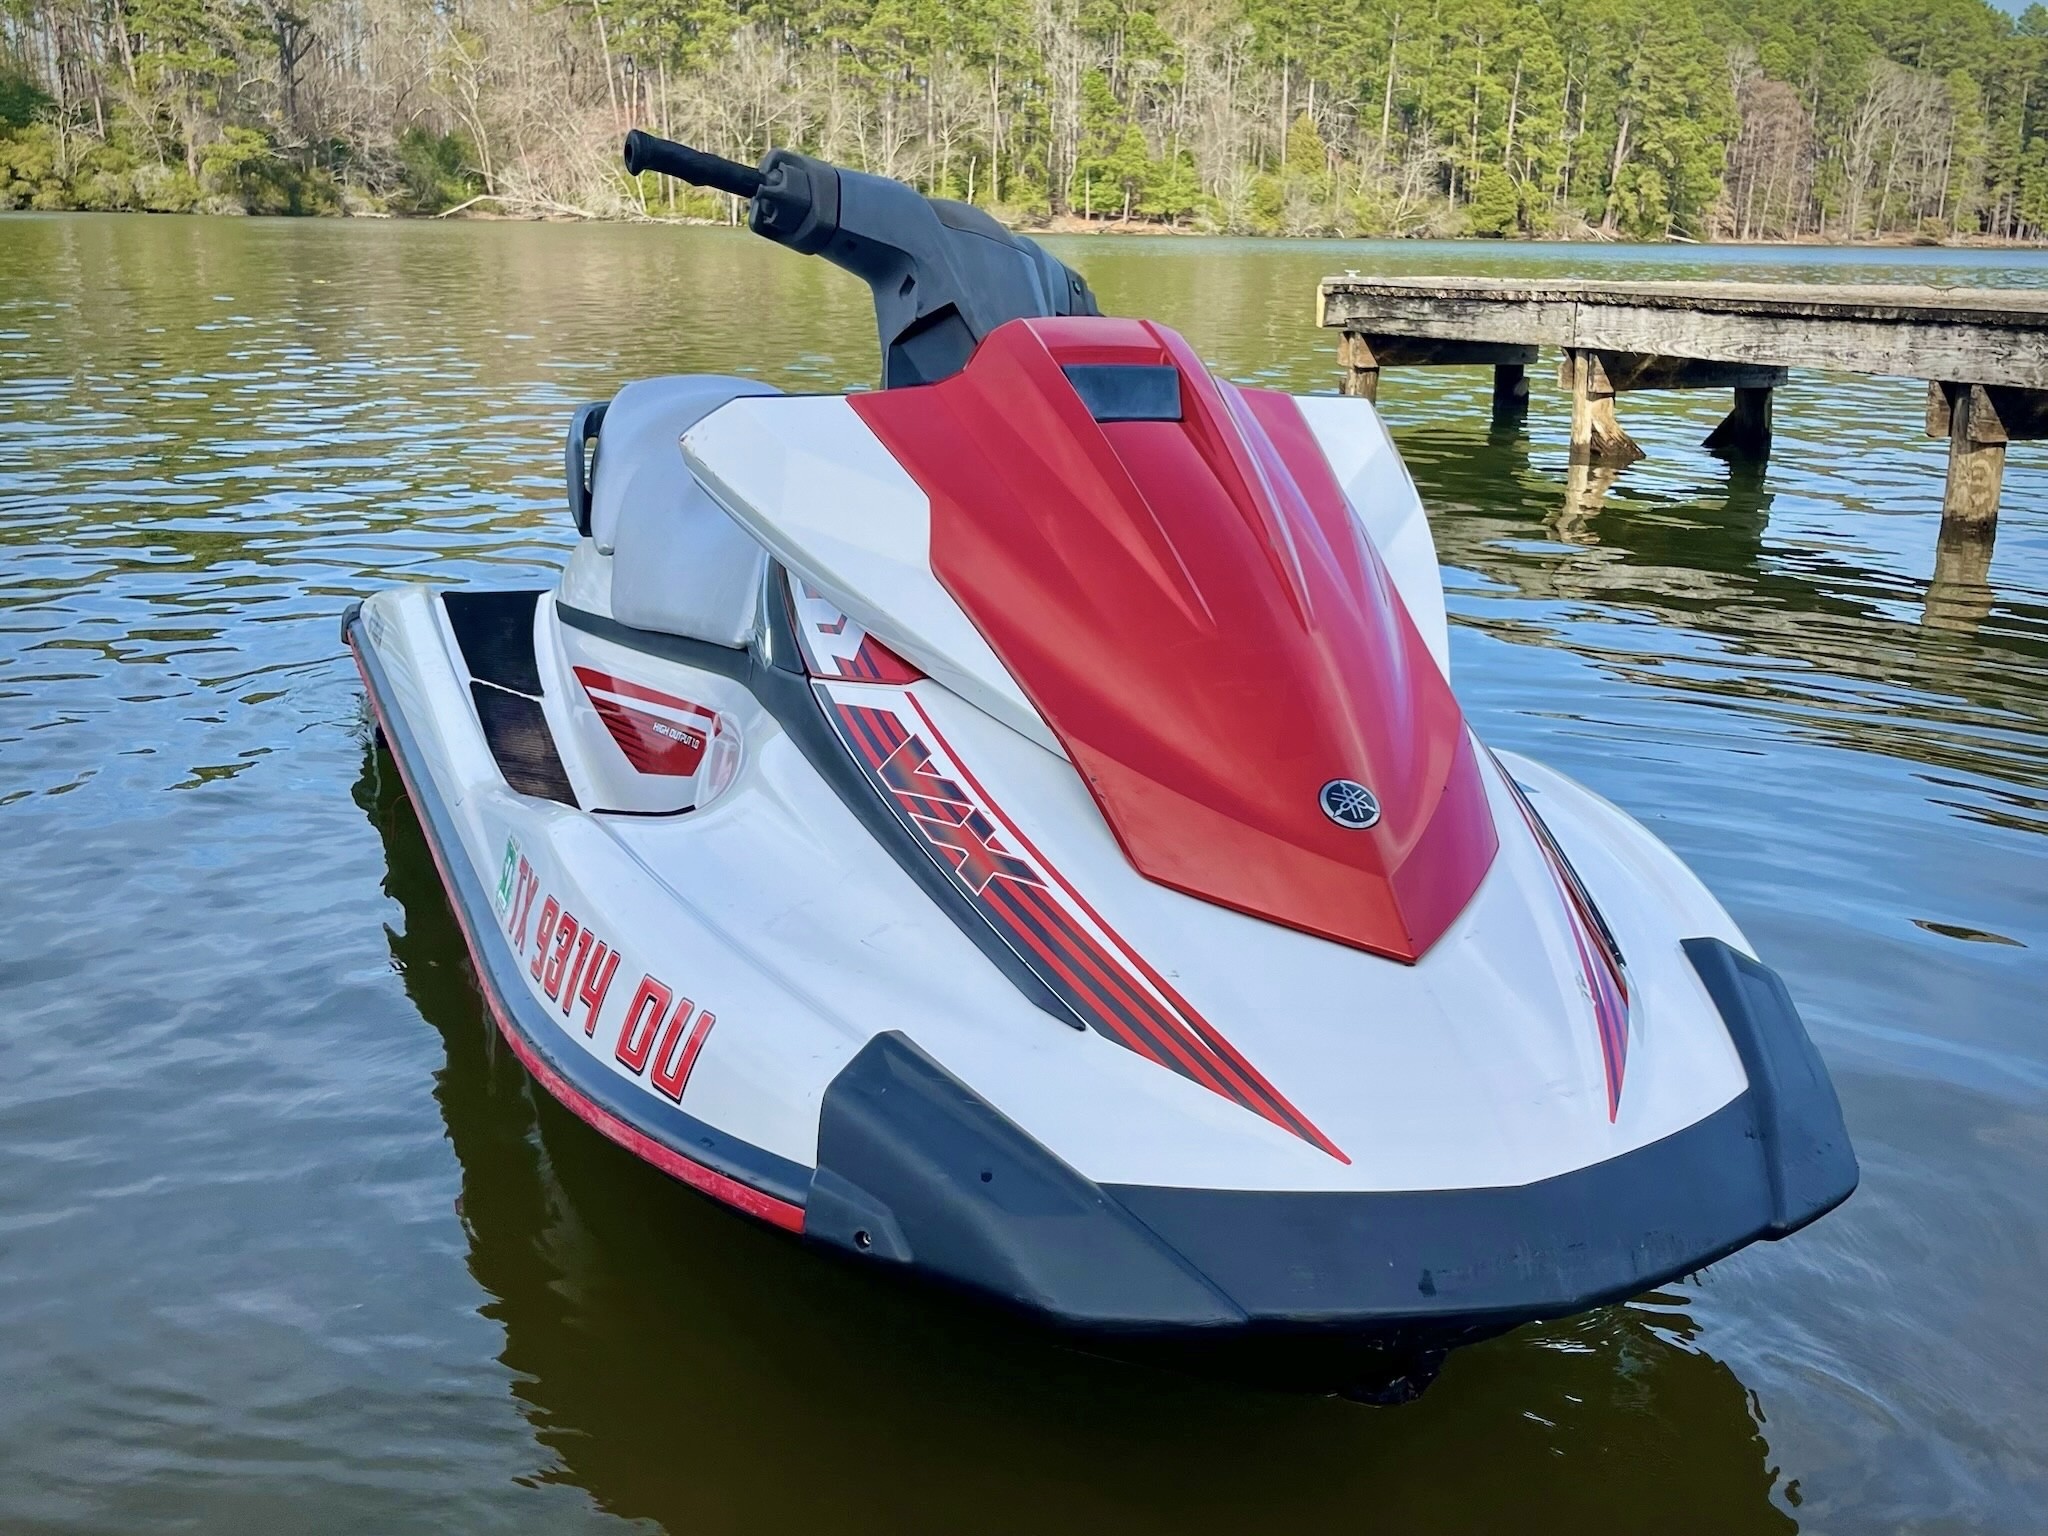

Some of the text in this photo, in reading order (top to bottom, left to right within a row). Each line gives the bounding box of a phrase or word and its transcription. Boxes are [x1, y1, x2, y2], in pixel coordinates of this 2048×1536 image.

[652, 722, 670, 736] HIGH
[669, 728, 693, 746] OUTPUT
[508, 854, 540, 956] TX
[530, 894, 621, 1039] 9314
